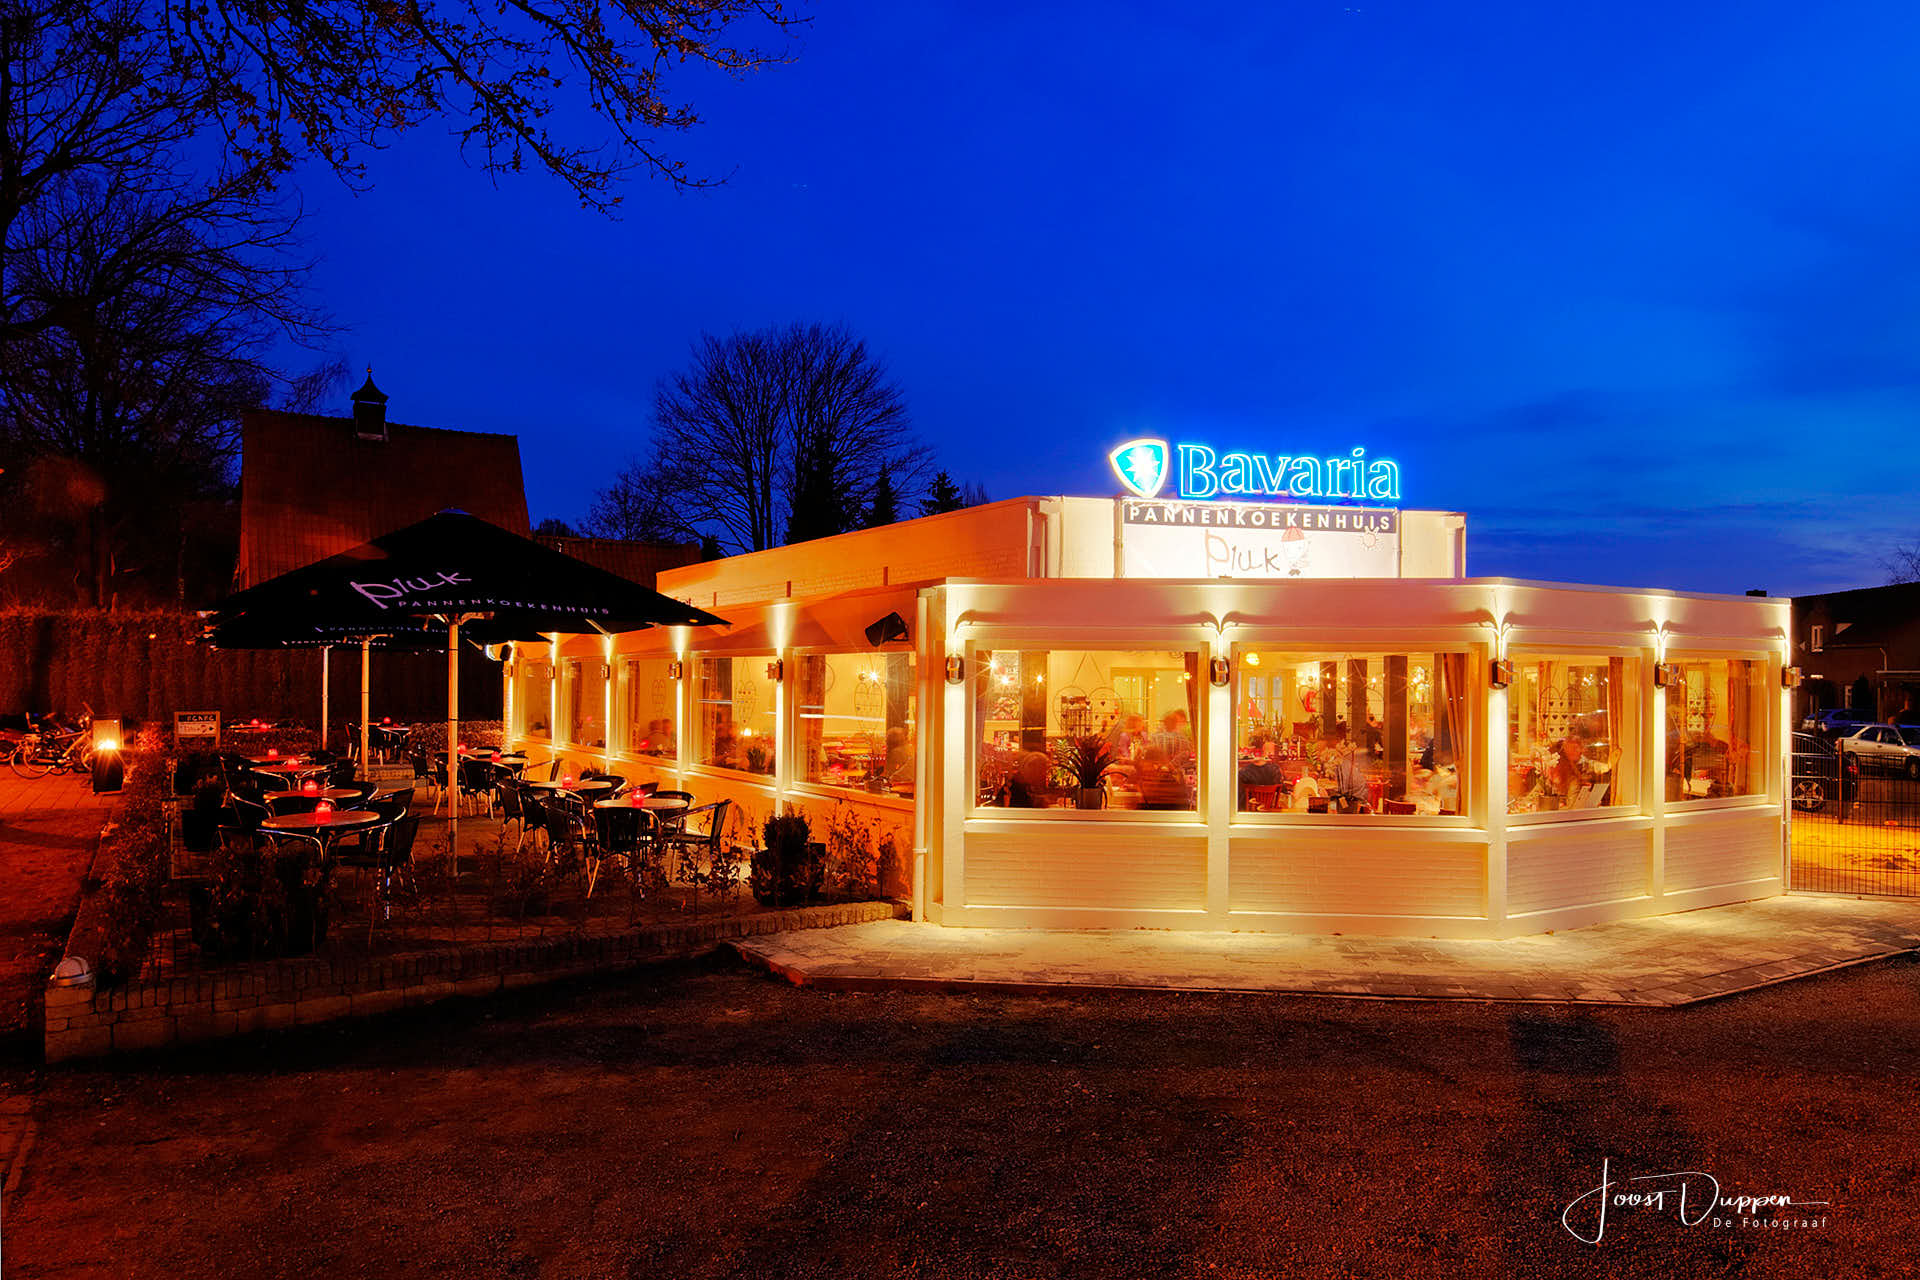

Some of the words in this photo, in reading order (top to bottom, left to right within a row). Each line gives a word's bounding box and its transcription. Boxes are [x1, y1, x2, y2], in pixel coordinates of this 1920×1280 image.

[1177, 443, 1401, 500] Bavaria
[1129, 505, 1391, 531] PANNENKOEKENHUIS
[1204, 528, 1281, 577] Pluk
[398, 598, 609, 615] PANNENKOEKENHUIS
